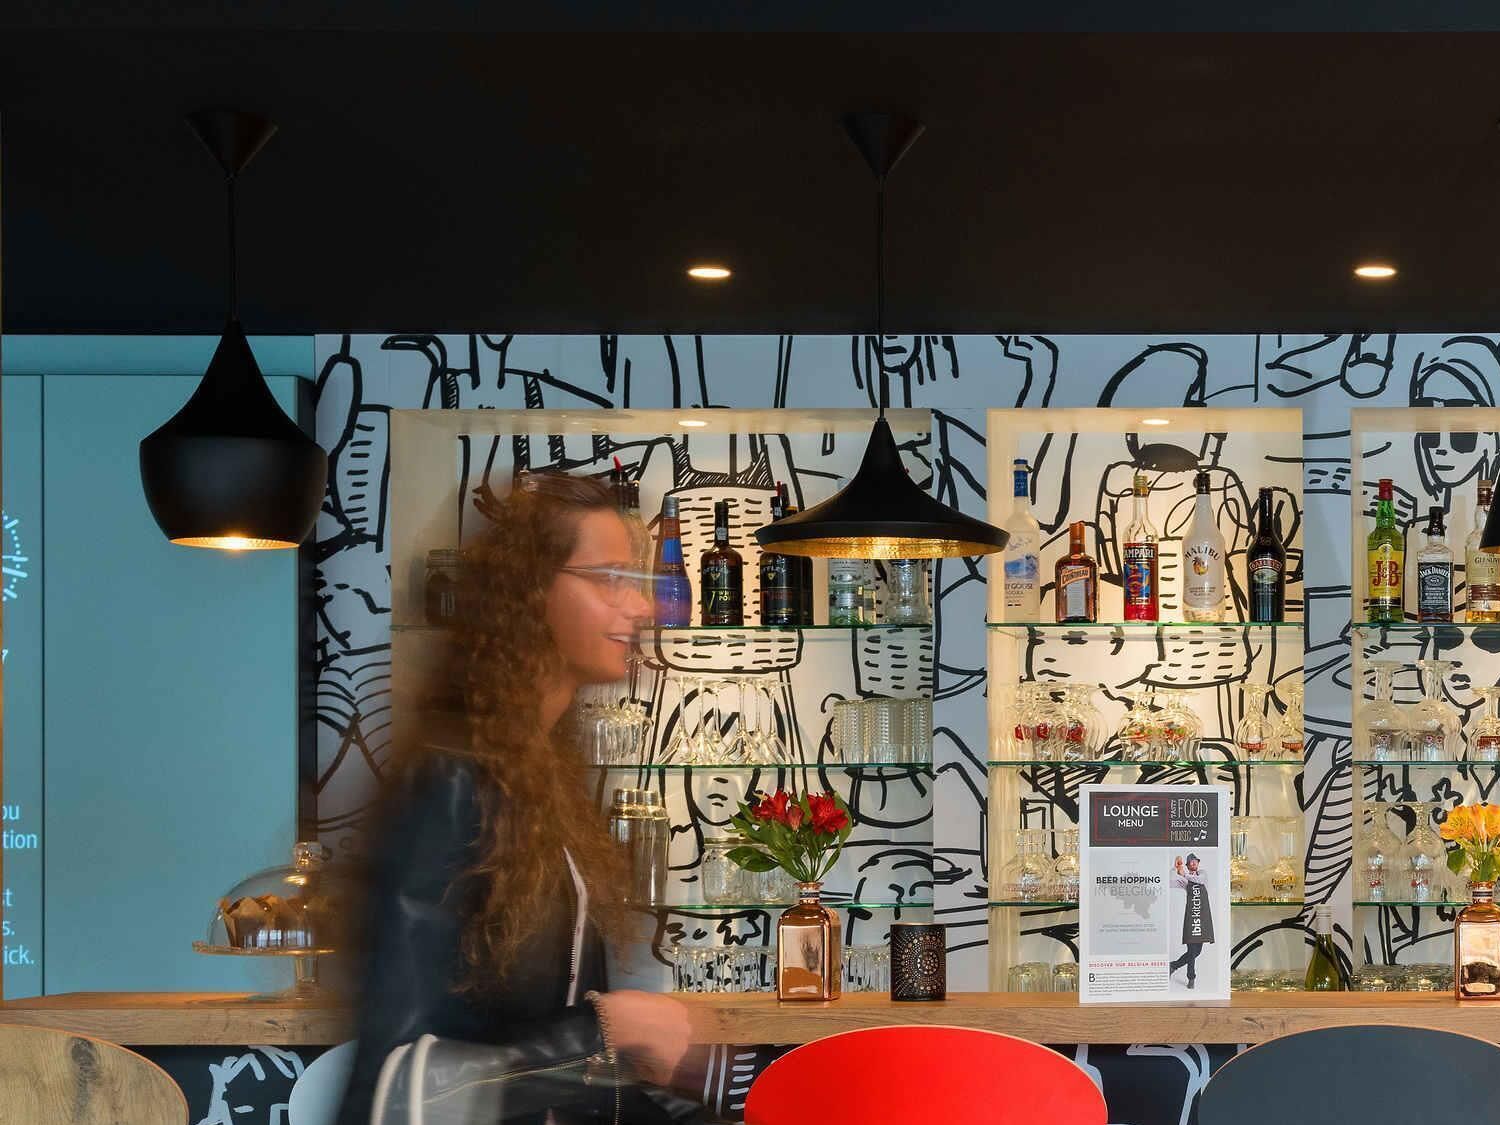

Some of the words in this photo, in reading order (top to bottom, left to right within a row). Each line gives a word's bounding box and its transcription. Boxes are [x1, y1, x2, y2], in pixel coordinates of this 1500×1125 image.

[1183, 545, 1220, 561] MALIBU
[1103, 805, 1159, 817] LOUNGE
[1178, 798, 1208, 819] FOOD
[1118, 819, 1144, 827] MENU
[1171, 820, 1208, 828] RELAXING
[1096, 876, 1118, 884] BEER
[1120, 876, 1161, 884] HOPPING
[1110, 886, 1162, 897] BELGIUM
[1191, 884, 1201, 917] kitchen
[1191, 918, 1201, 936] ibis
